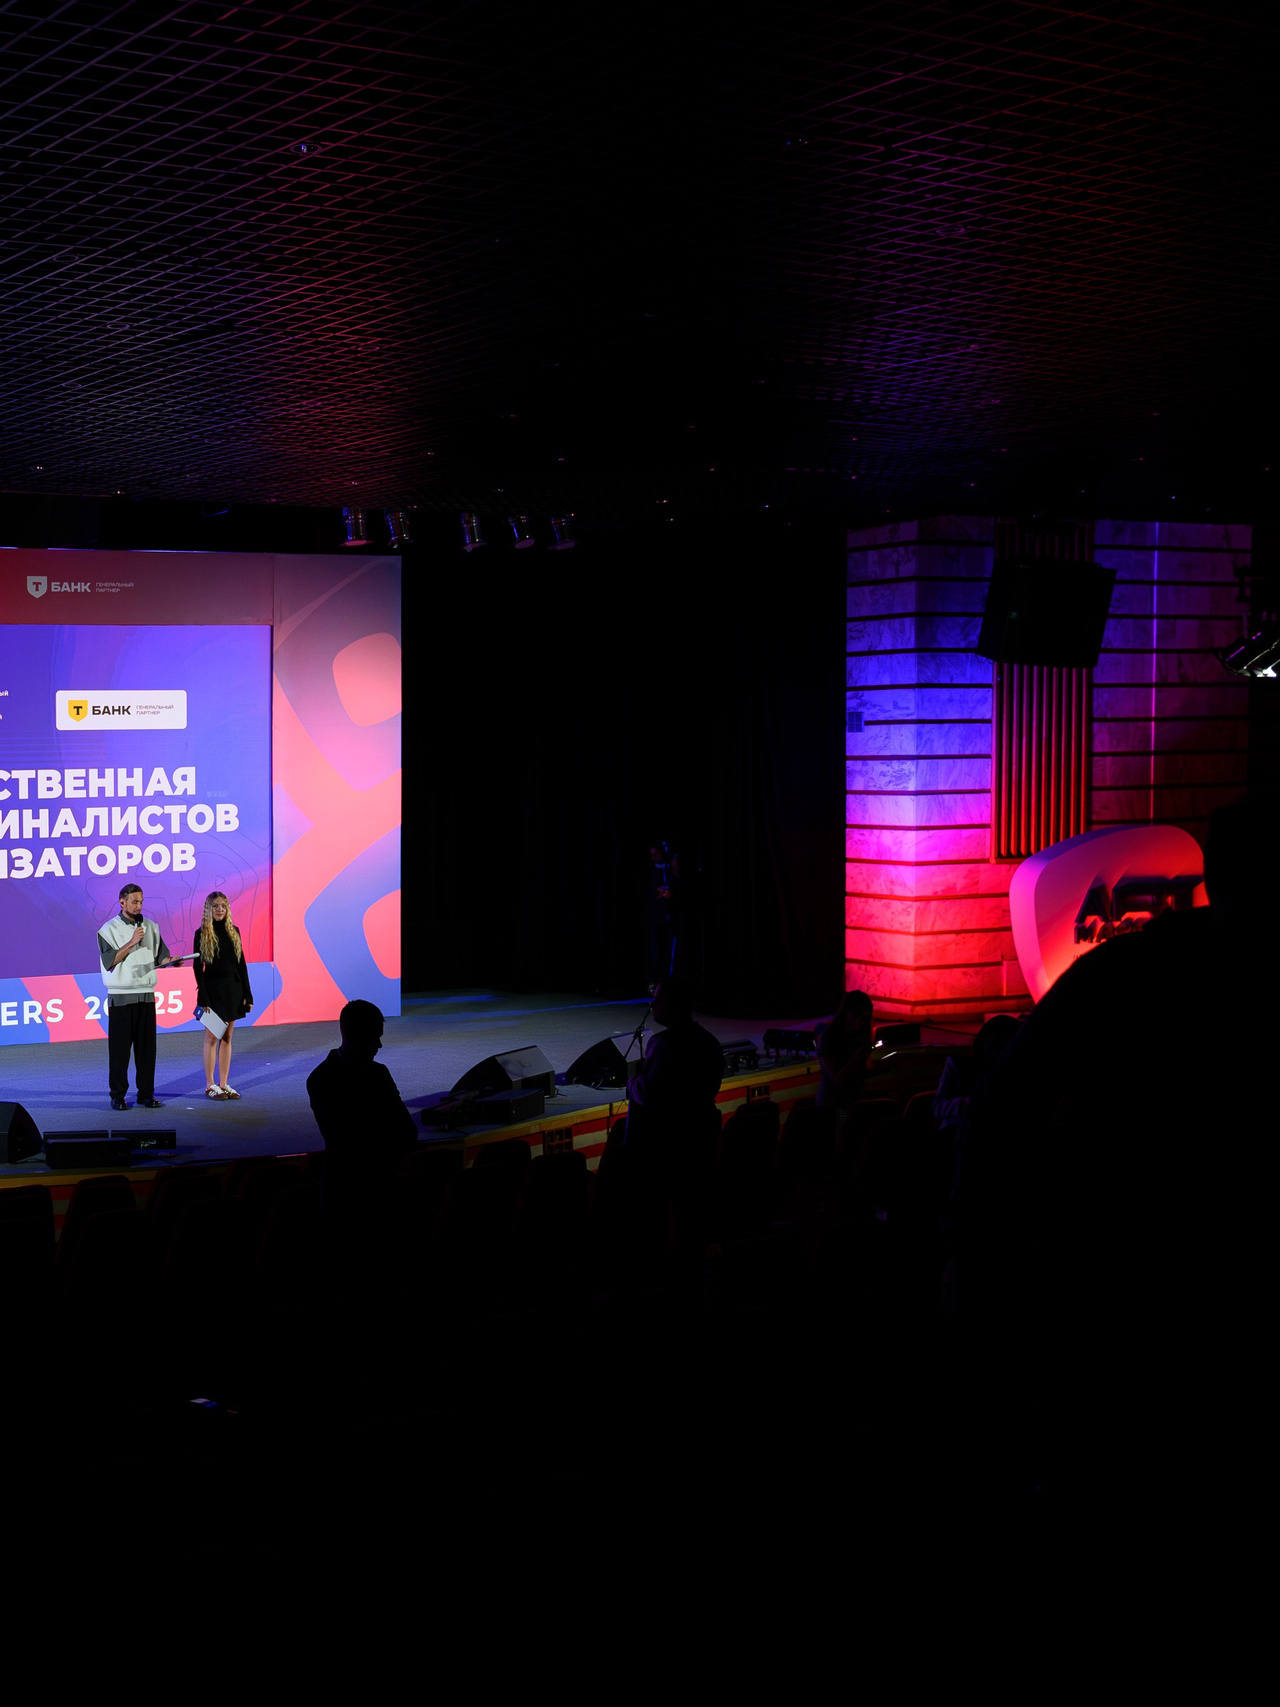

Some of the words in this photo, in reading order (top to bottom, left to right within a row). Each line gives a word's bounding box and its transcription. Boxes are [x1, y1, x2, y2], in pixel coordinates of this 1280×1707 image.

[51, 582, 92, 592] БАНК
[92, 705, 132, 716] БАНК
[84, 990, 183, 1020] 225
